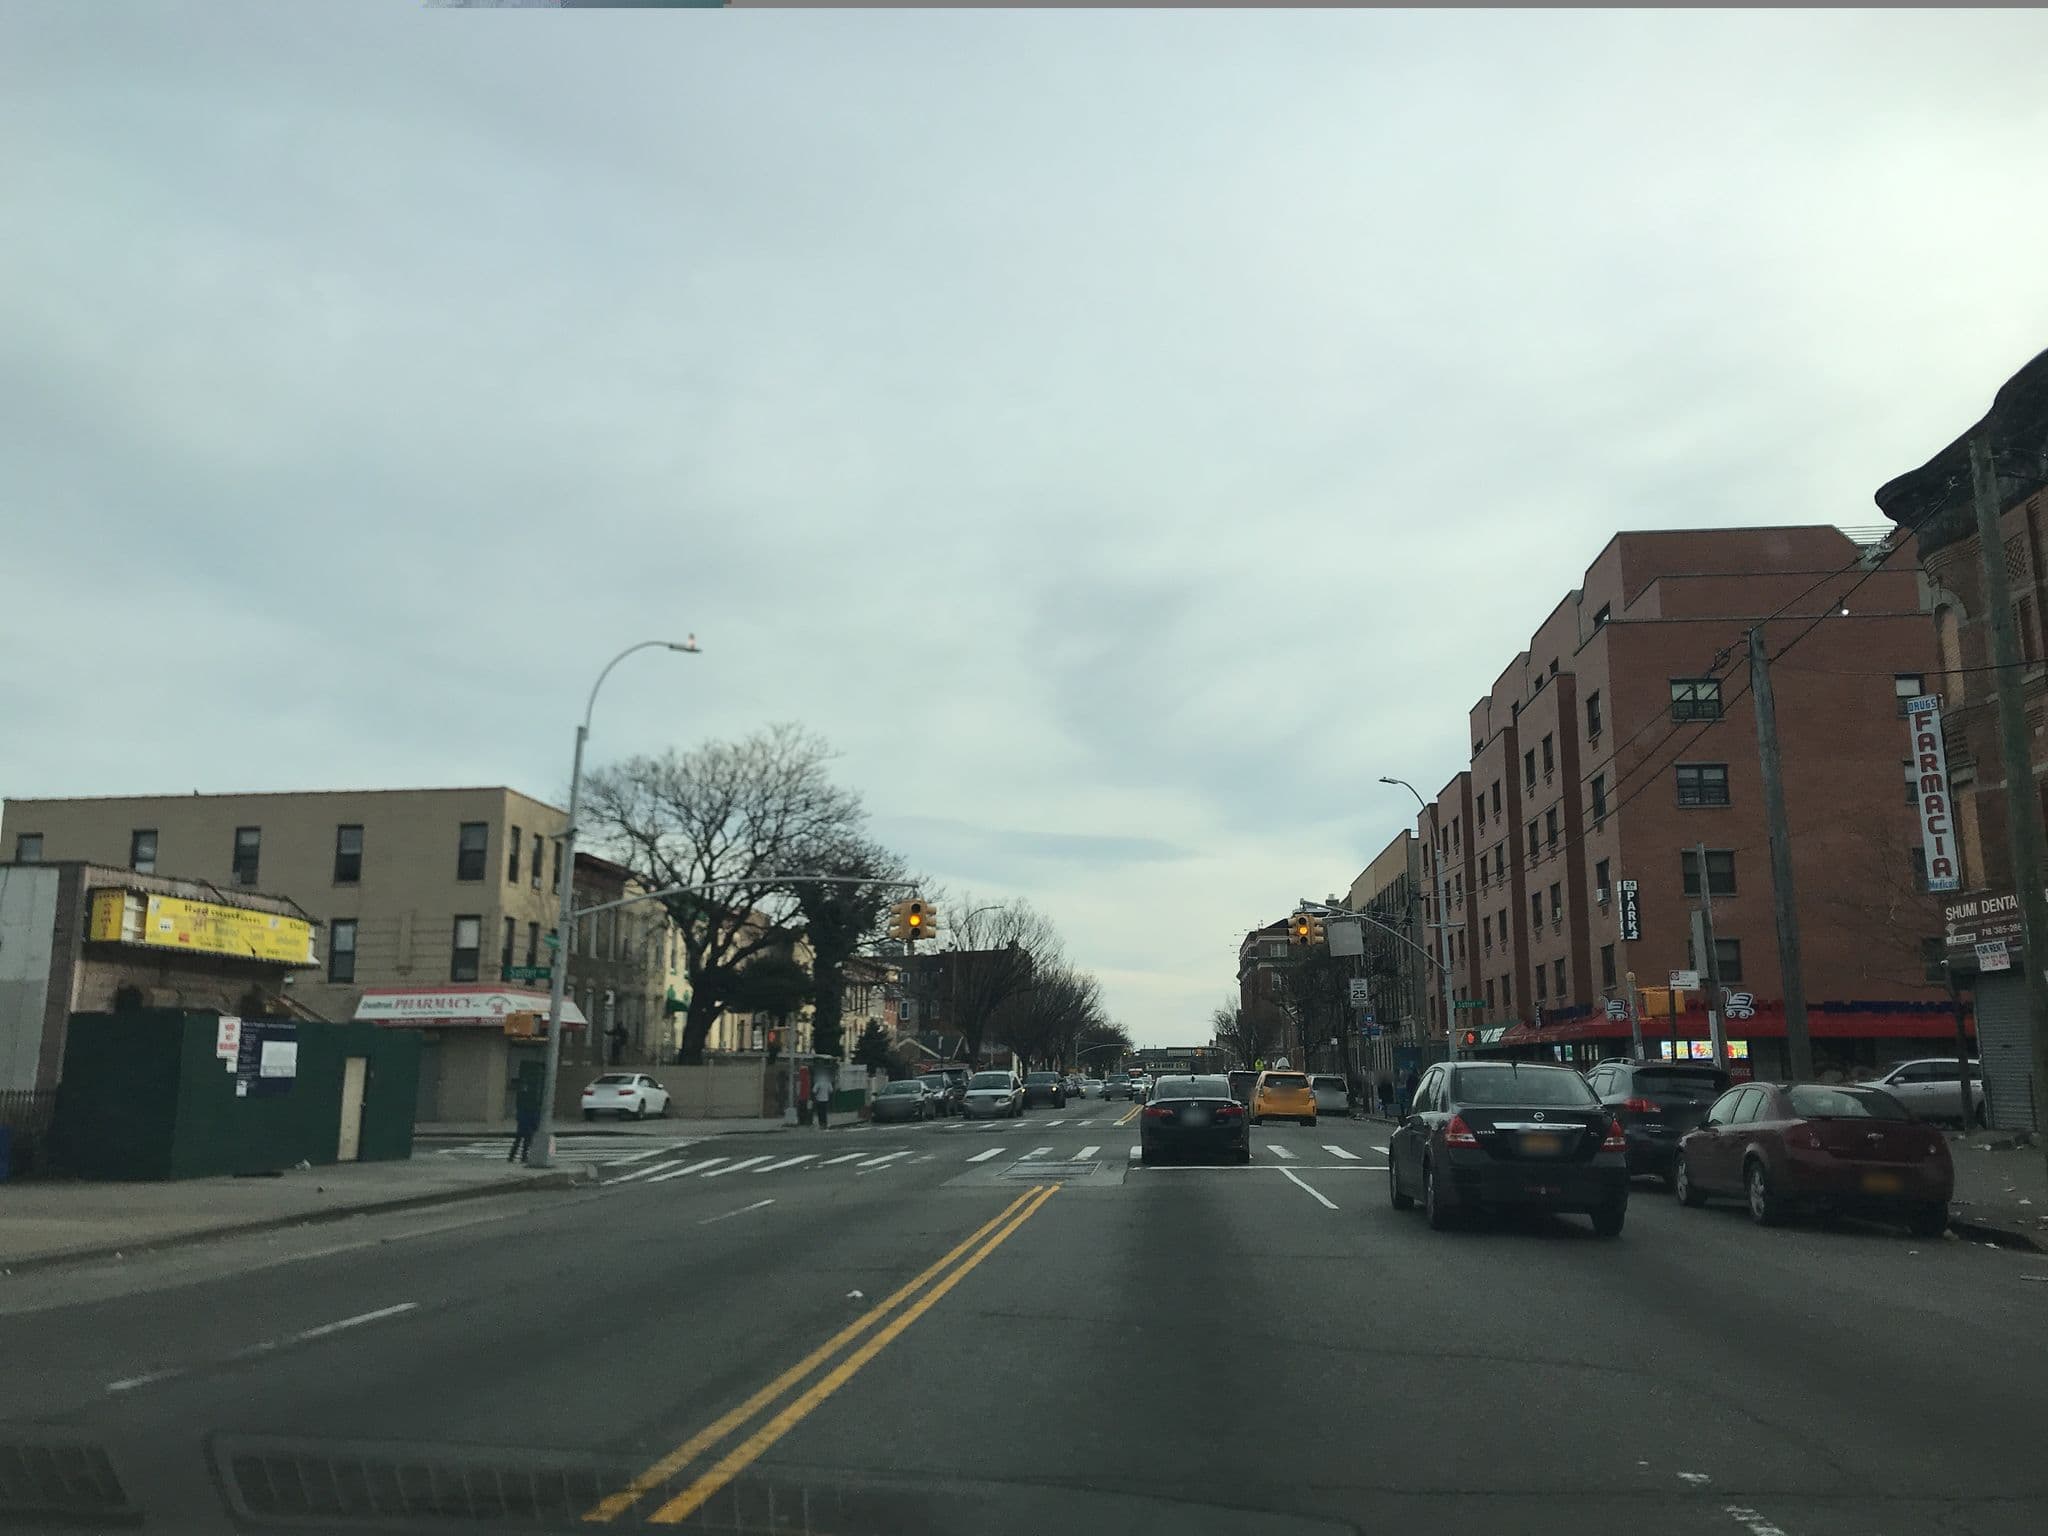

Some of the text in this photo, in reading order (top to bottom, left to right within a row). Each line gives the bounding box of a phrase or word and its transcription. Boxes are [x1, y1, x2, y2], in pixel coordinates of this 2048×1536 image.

[1908, 698, 1937, 713] DRUGS
[1915, 710, 1952, 878] FARMACIA
[1627, 891, 1637, 931] PARK
[1945, 894, 2018, 921] SHUMI DENTA
[394, 998, 471, 1009] PHARMACY
[1353, 990, 1366, 999] 25
